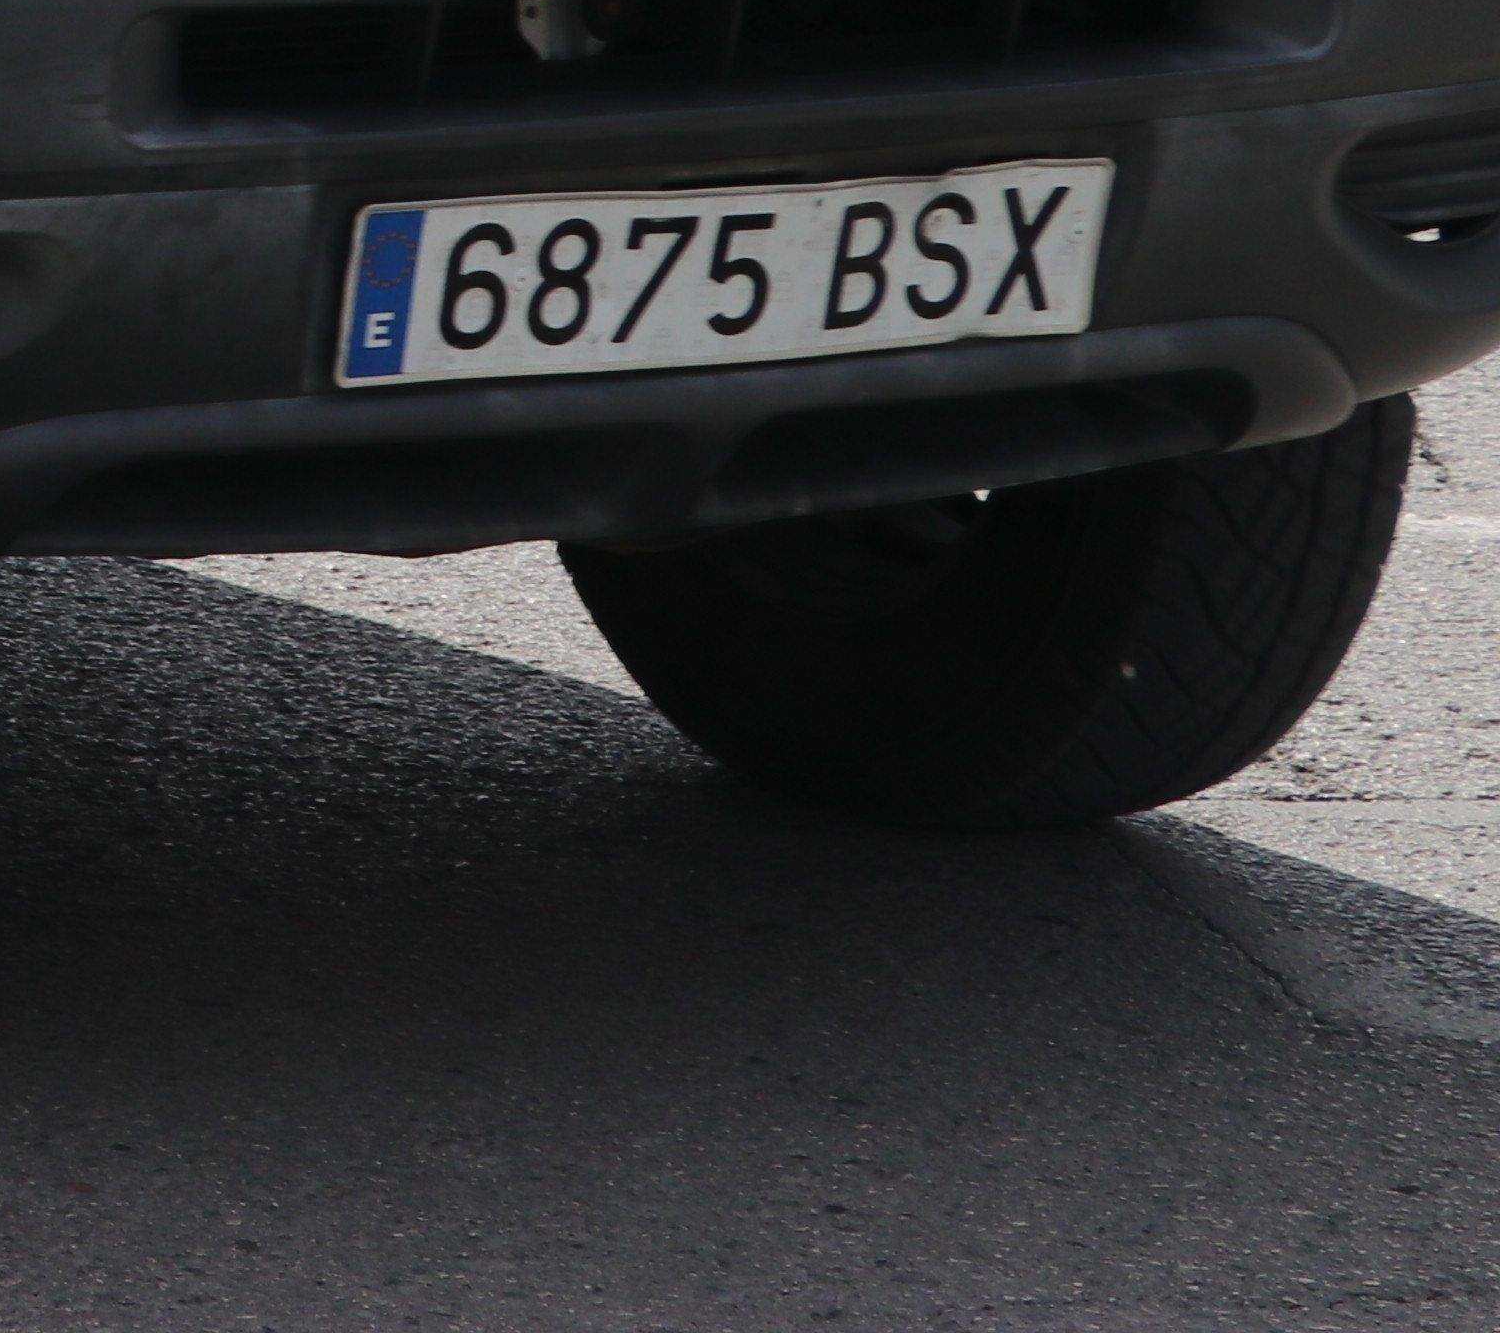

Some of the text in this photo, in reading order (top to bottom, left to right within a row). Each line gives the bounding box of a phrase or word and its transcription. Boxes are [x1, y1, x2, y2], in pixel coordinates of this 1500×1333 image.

[438, 184, 1072, 352] 6875 BSX
[362, 310, 395, 350] E
